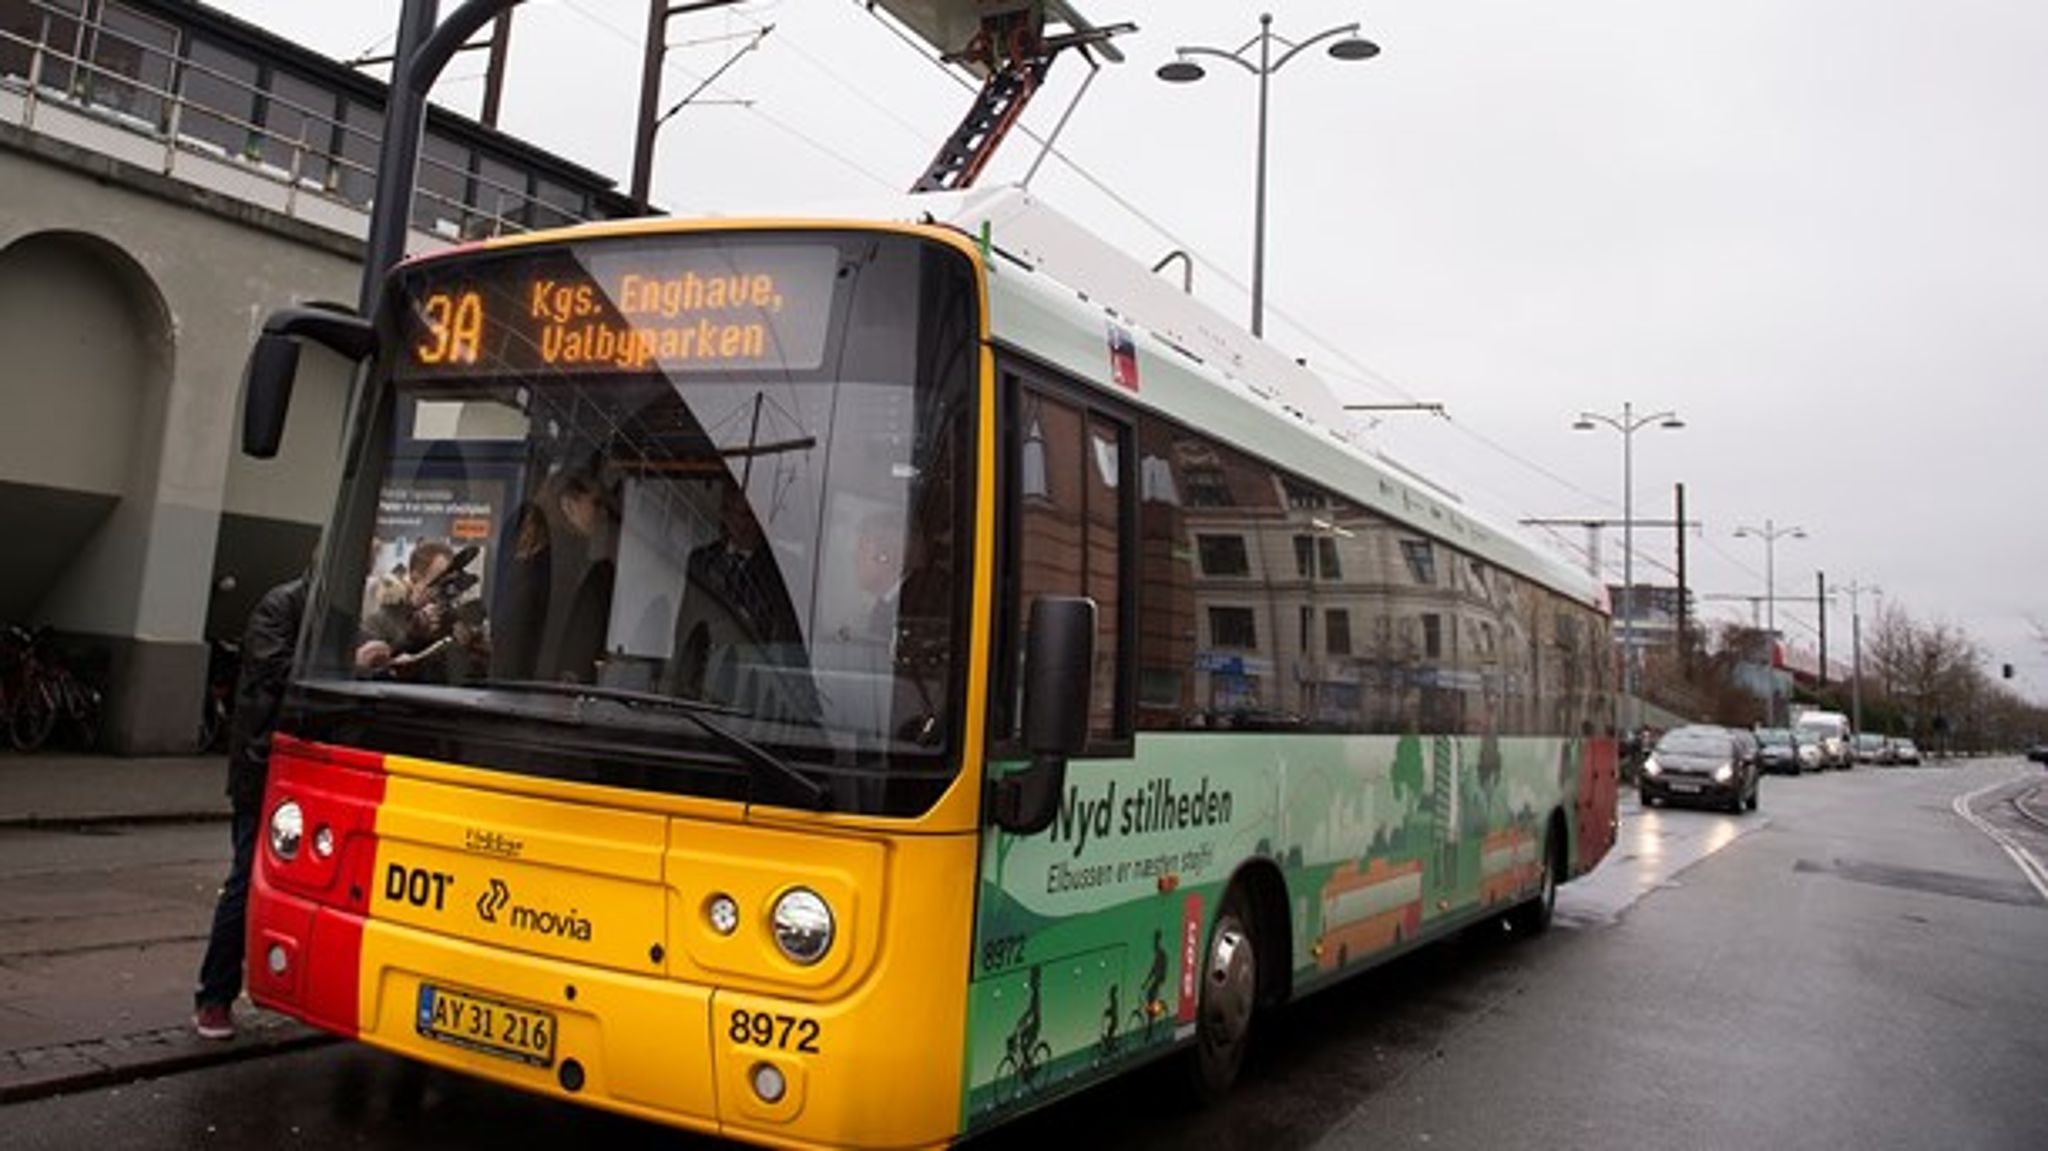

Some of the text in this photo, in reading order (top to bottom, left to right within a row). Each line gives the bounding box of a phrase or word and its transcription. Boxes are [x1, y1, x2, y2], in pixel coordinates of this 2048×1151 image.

[531, 271, 784, 323] Kgs. Enghave,
[417, 291, 484, 365] 3A
[540, 321, 764, 367] Valbyparken
[1049, 775, 1233, 858] Nyd stilheden
[384, 861, 454, 912] DOT
[510, 904, 593, 942] movia
[433, 995, 465, 1029] AY
[468, 1005, 493, 1039] 31
[502, 1012, 549, 1052] 216
[728, 1008, 821, 1054] 8972
